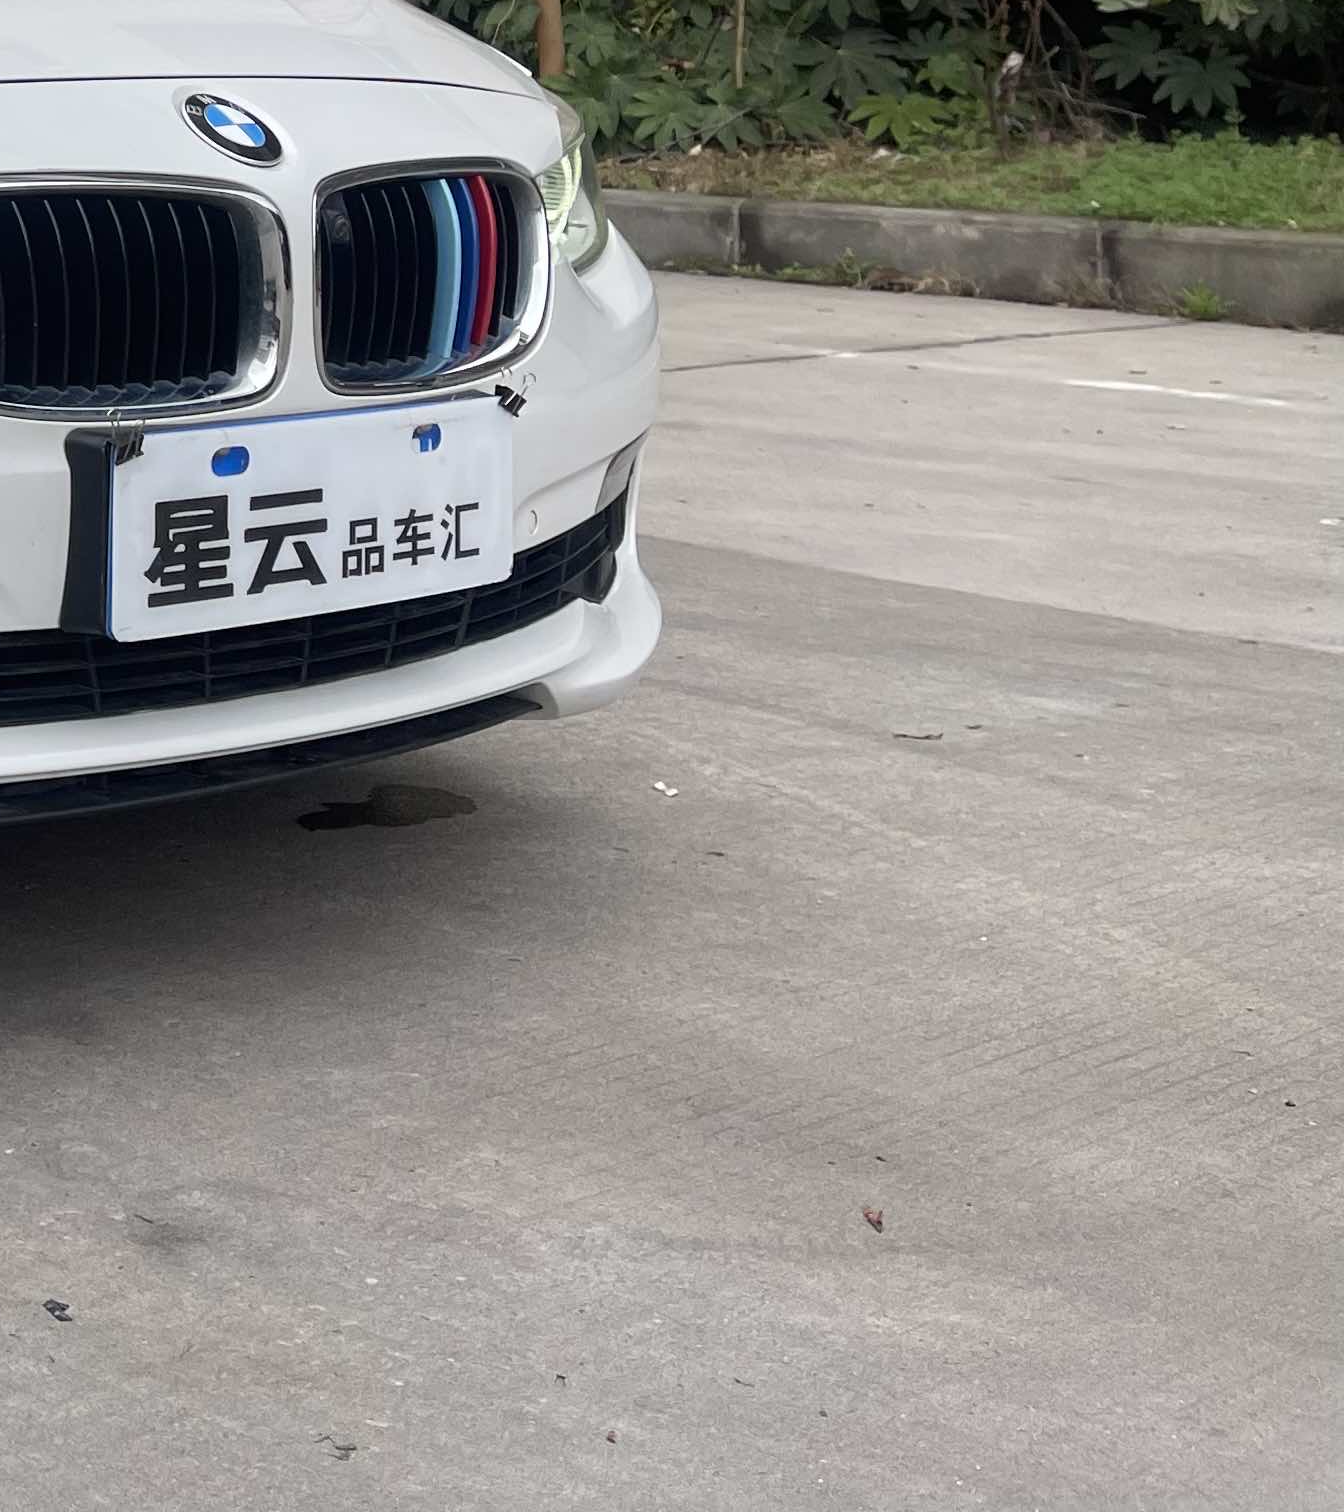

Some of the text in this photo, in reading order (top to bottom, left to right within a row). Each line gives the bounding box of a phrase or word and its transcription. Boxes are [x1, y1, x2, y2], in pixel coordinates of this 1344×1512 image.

[144, 488, 480, 608] 星云品车汇
